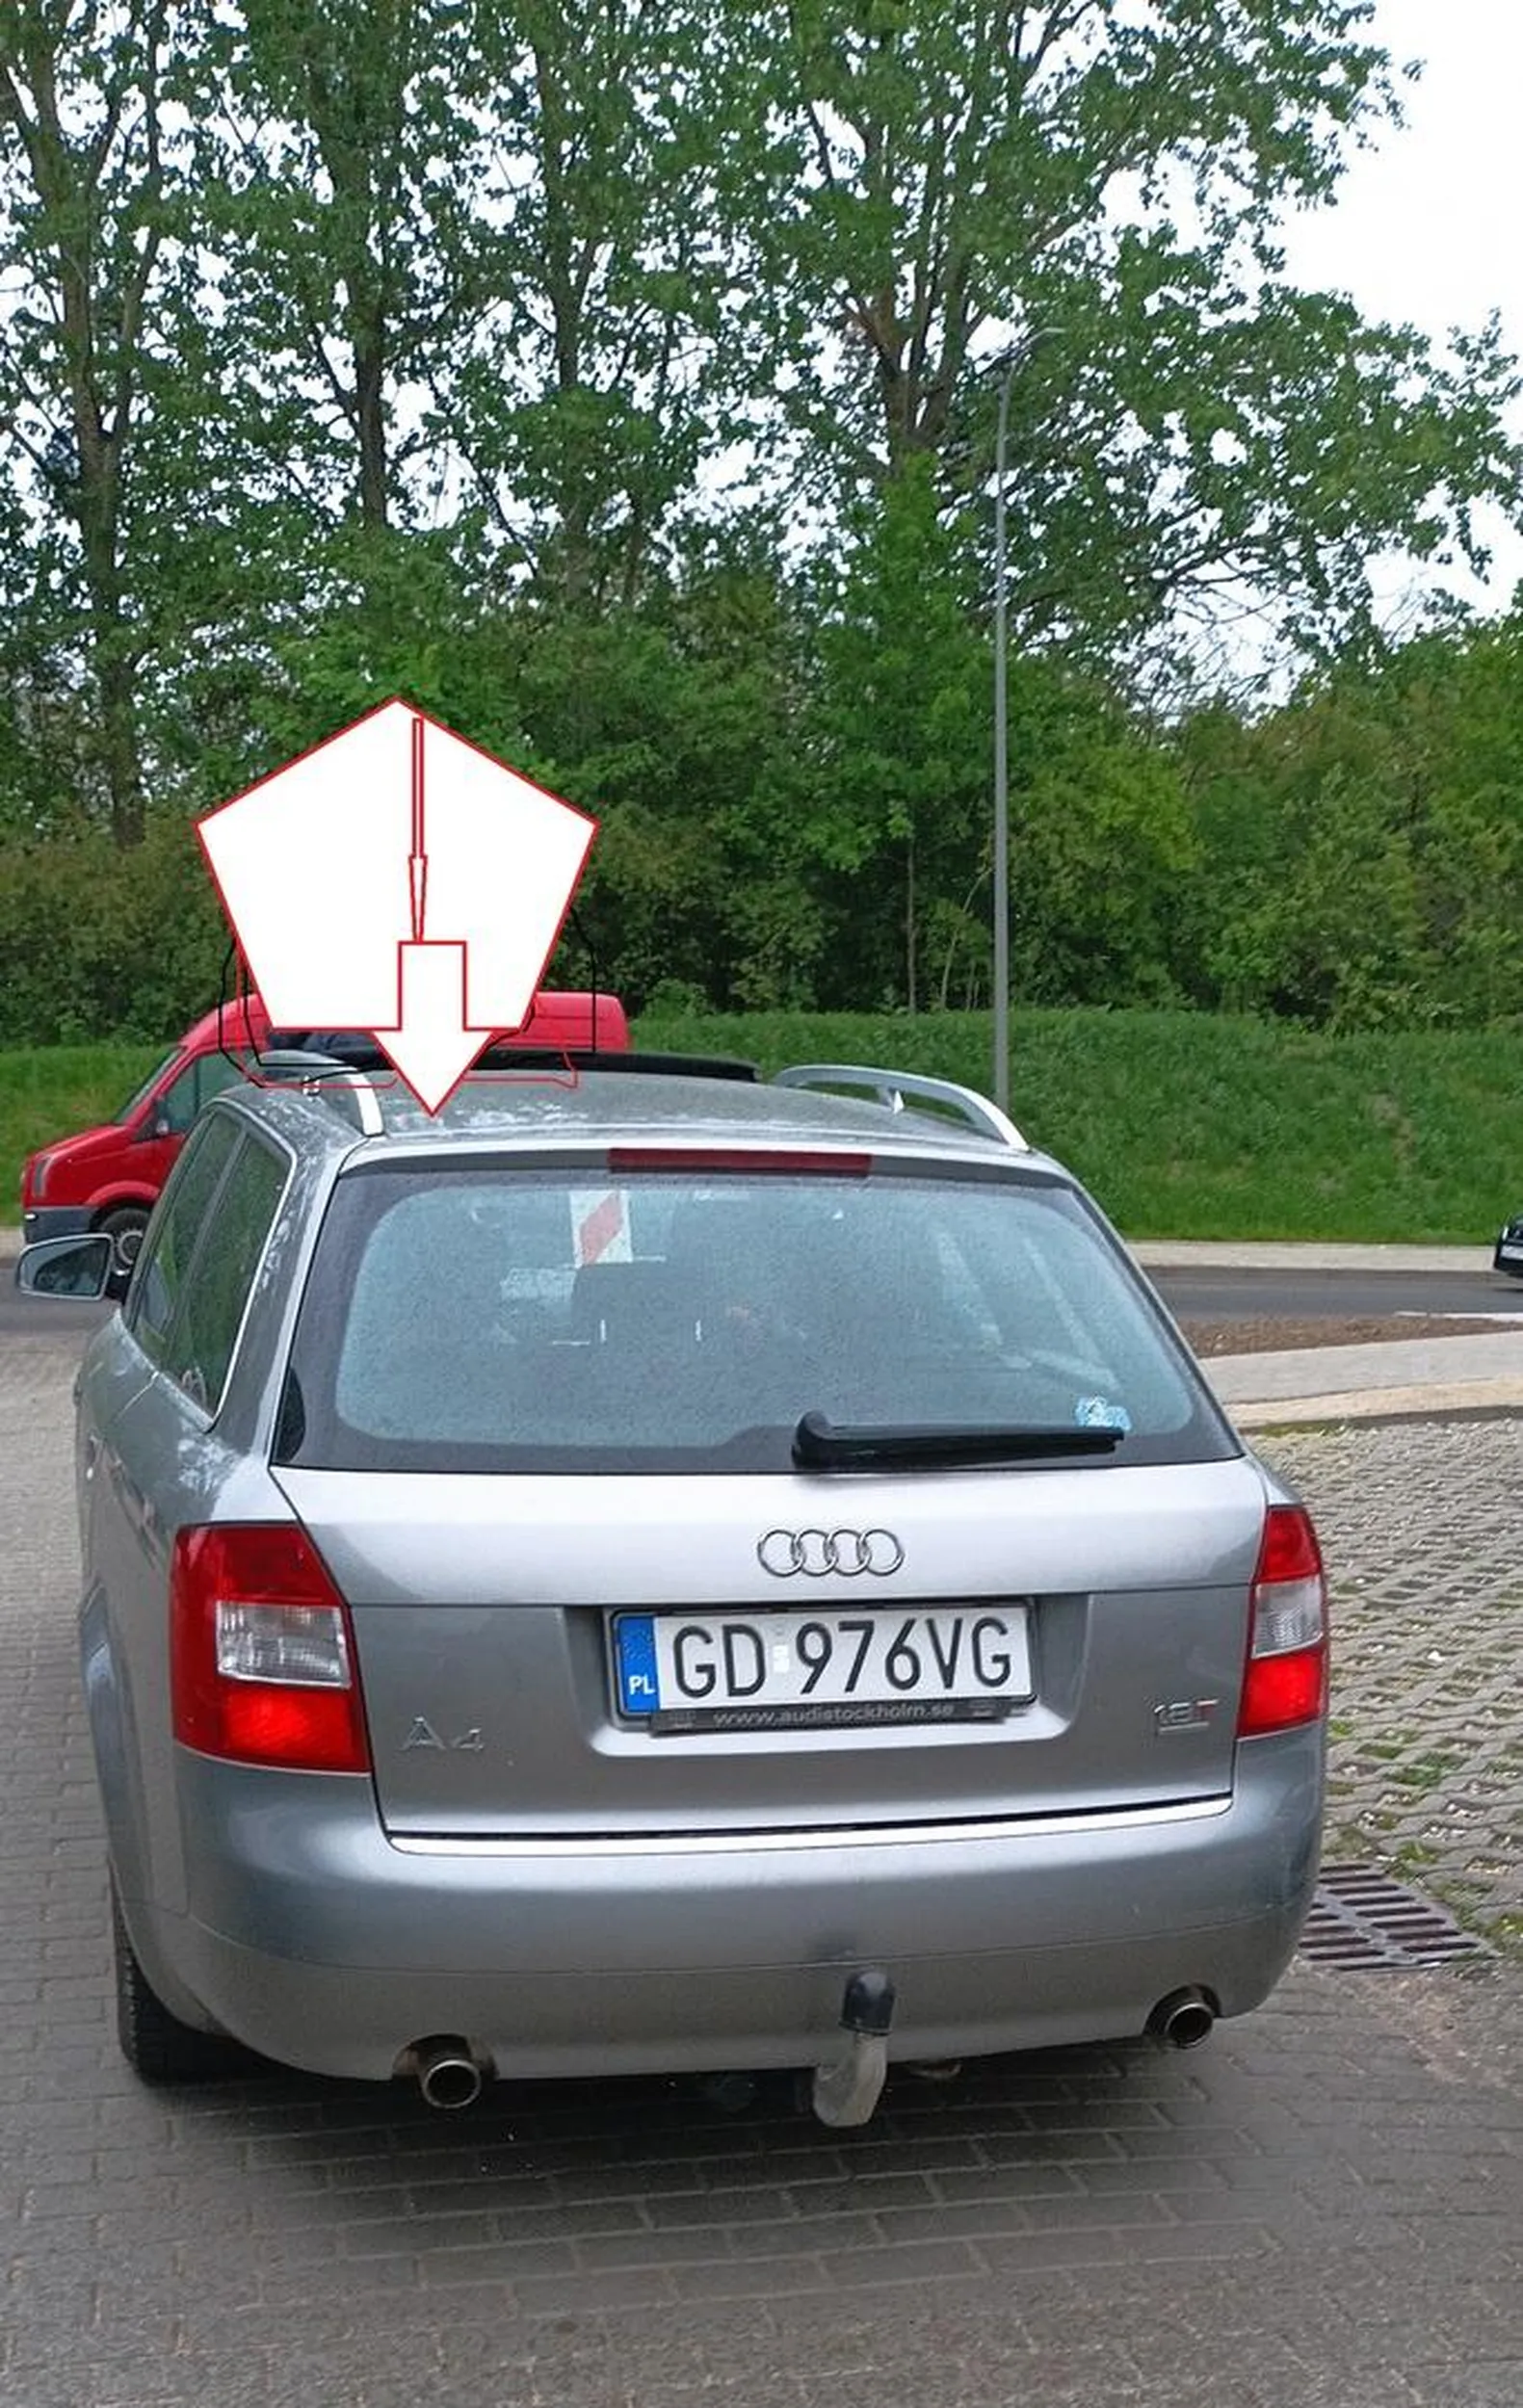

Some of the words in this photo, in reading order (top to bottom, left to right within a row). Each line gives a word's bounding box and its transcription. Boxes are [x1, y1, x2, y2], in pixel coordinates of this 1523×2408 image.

[672, 1624, 767, 1699] GD
[795, 1616, 1012, 1695] 976VG
[628, 1673, 656, 1696] PL
[712, 1702, 956, 1728] www.audistockholm.se
